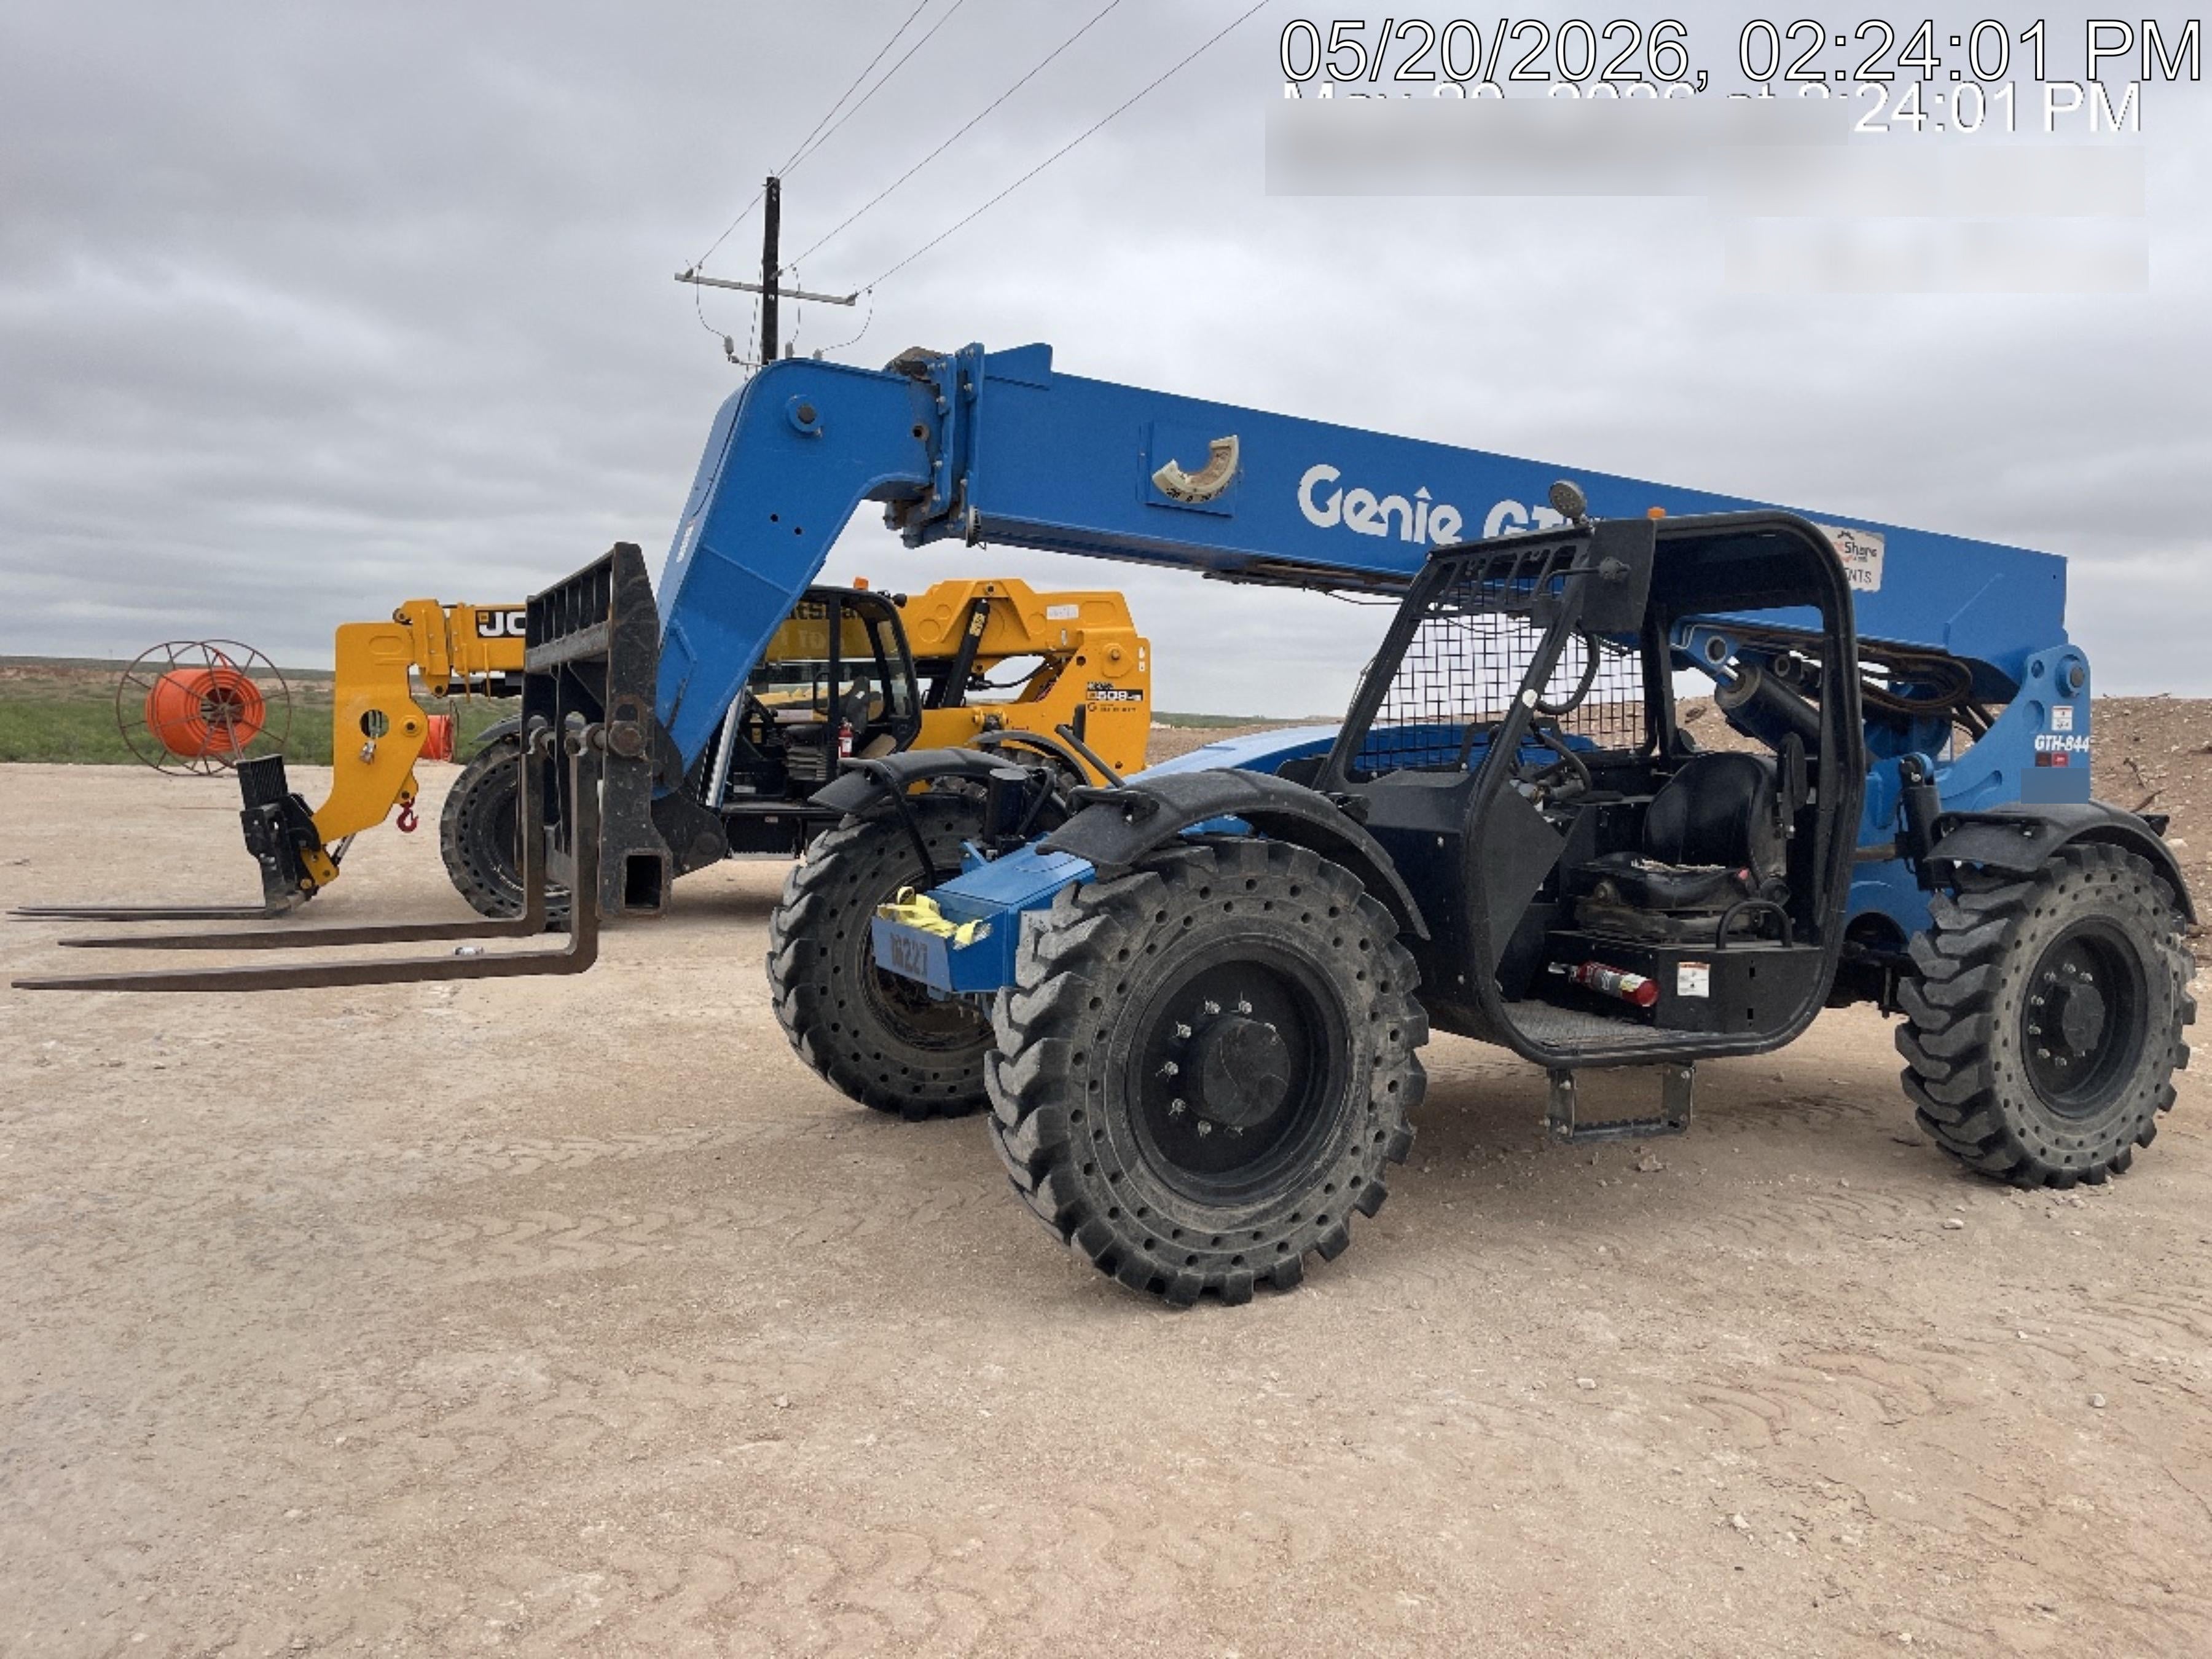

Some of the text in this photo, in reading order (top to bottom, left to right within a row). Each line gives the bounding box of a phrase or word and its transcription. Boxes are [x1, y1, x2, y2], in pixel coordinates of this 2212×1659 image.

[1297, 464, 1573, 545] Genie GT
[478, 611, 526, 637] JC
[2034, 734, 2090, 752] GTH-844
